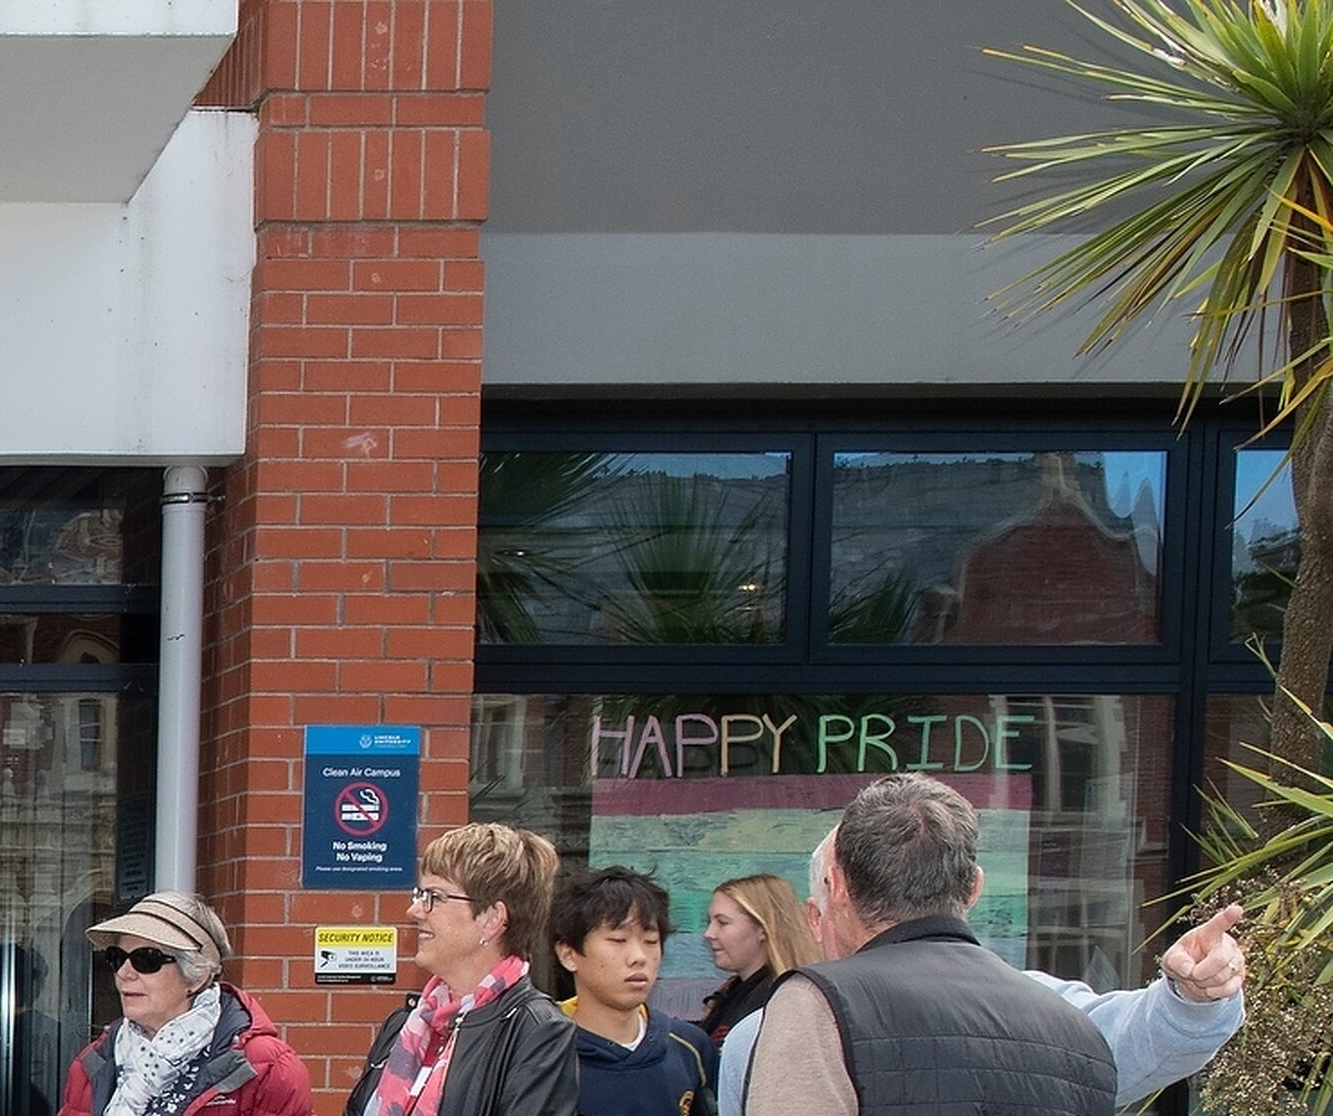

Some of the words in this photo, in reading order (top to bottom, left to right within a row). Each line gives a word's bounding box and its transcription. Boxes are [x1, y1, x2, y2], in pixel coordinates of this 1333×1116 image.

[591, 713, 798, 779] HAPPY
[817, 713, 1035, 774] PRIDE
[322, 767, 348, 777] Clean
[349, 767, 363, 777] Air
[363, 767, 401, 778] Campus
[332, 841, 347, 850] No
[347, 841, 388, 852] Smoking
[336, 853, 350, 862] No
[350, 852, 383, 863] Vaping
[319, 933, 360, 943] SECURITY
[363, 932, 394, 943] NOTICE
